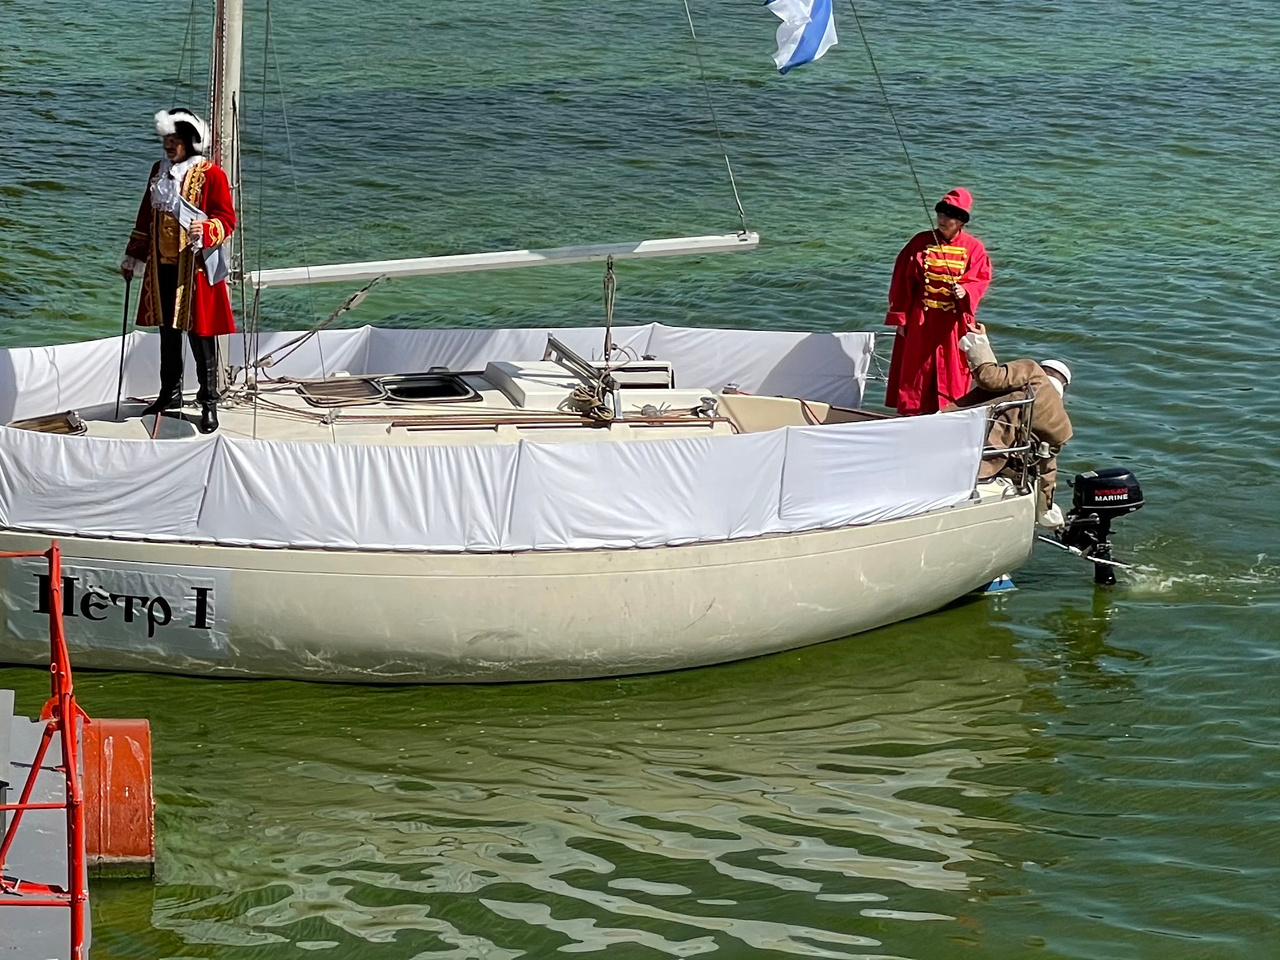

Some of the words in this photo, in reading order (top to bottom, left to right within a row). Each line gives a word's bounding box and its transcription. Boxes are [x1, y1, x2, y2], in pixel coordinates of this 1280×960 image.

[1094, 493, 1128, 502] MARINE
[32, 573, 172, 638] Пётр
[189, 586, 213, 629] I
